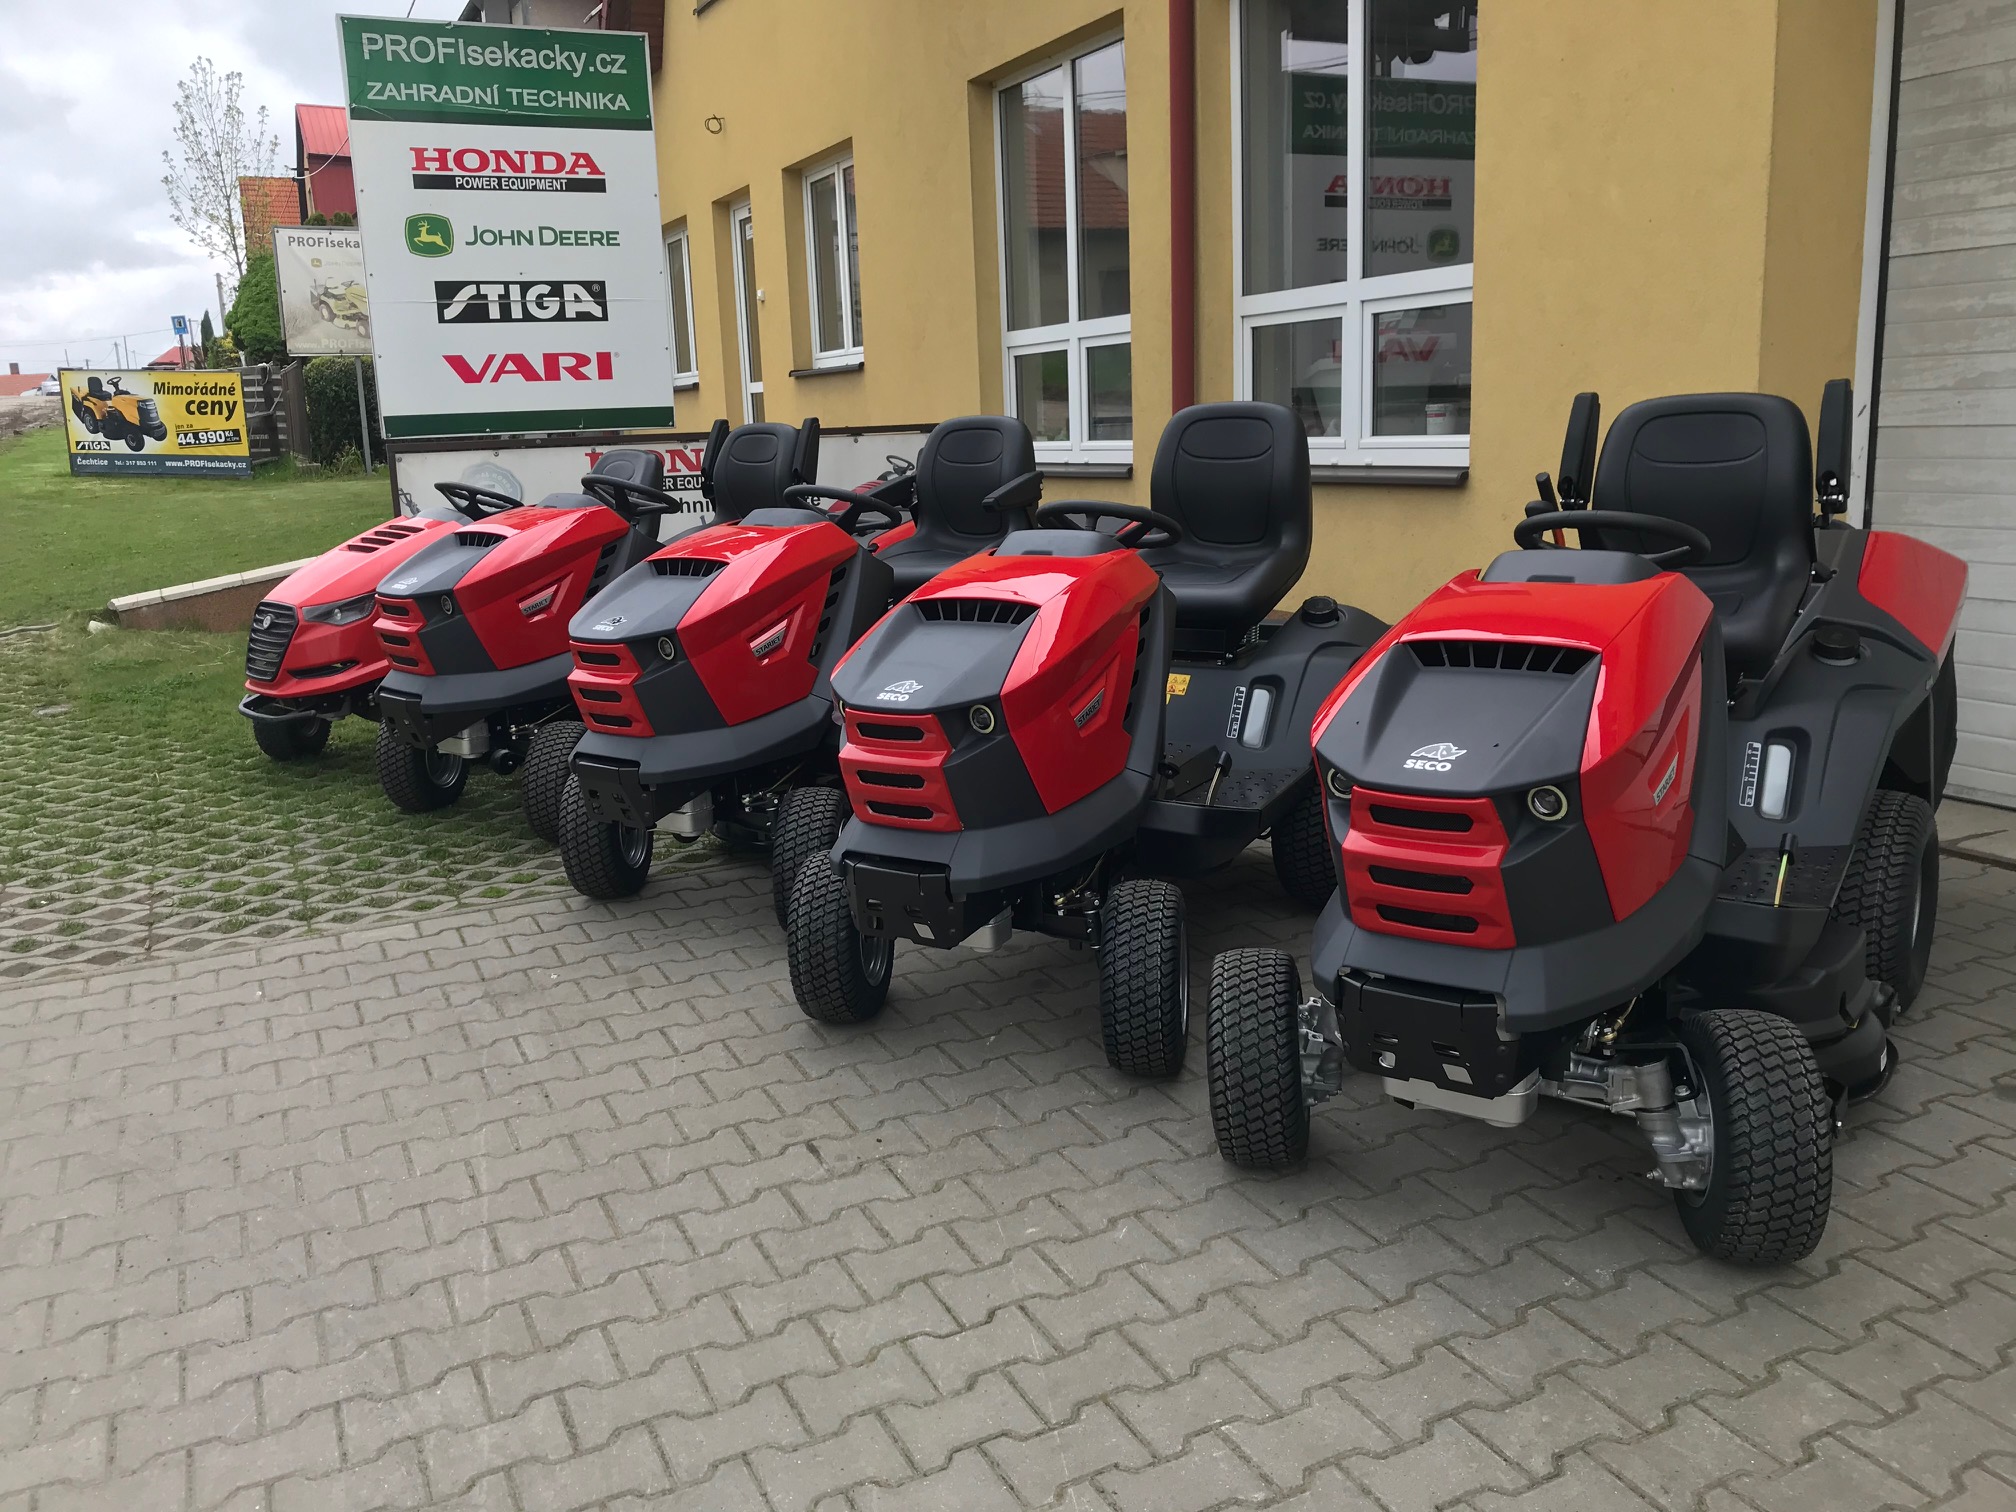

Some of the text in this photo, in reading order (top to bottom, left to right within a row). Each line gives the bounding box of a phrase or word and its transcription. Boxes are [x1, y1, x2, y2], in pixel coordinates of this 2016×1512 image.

[361, 32, 627, 77] PROFIsekacky.cz
[366, 80, 631, 111] ZAHRADNÍ TECHNIKA
[409, 147, 606, 176] HONDA
[455, 176, 568, 191] POWER EQUIPMENT
[465, 225, 621, 247] JOHN DEERE
[441, 352, 614, 384] VARI
[153, 382, 236, 396] Mimořádné
[185, 399, 238, 422] ceny
[177, 430, 226, 445] 44.990
[77, 441, 110, 450] STIGA
[76, 456, 109, 466] Čechtice
[165, 459, 247, 469] www.PROFIsekacky.cz
[876, 692, 910, 702] SECO
[1403, 758, 1452, 772] SECO
